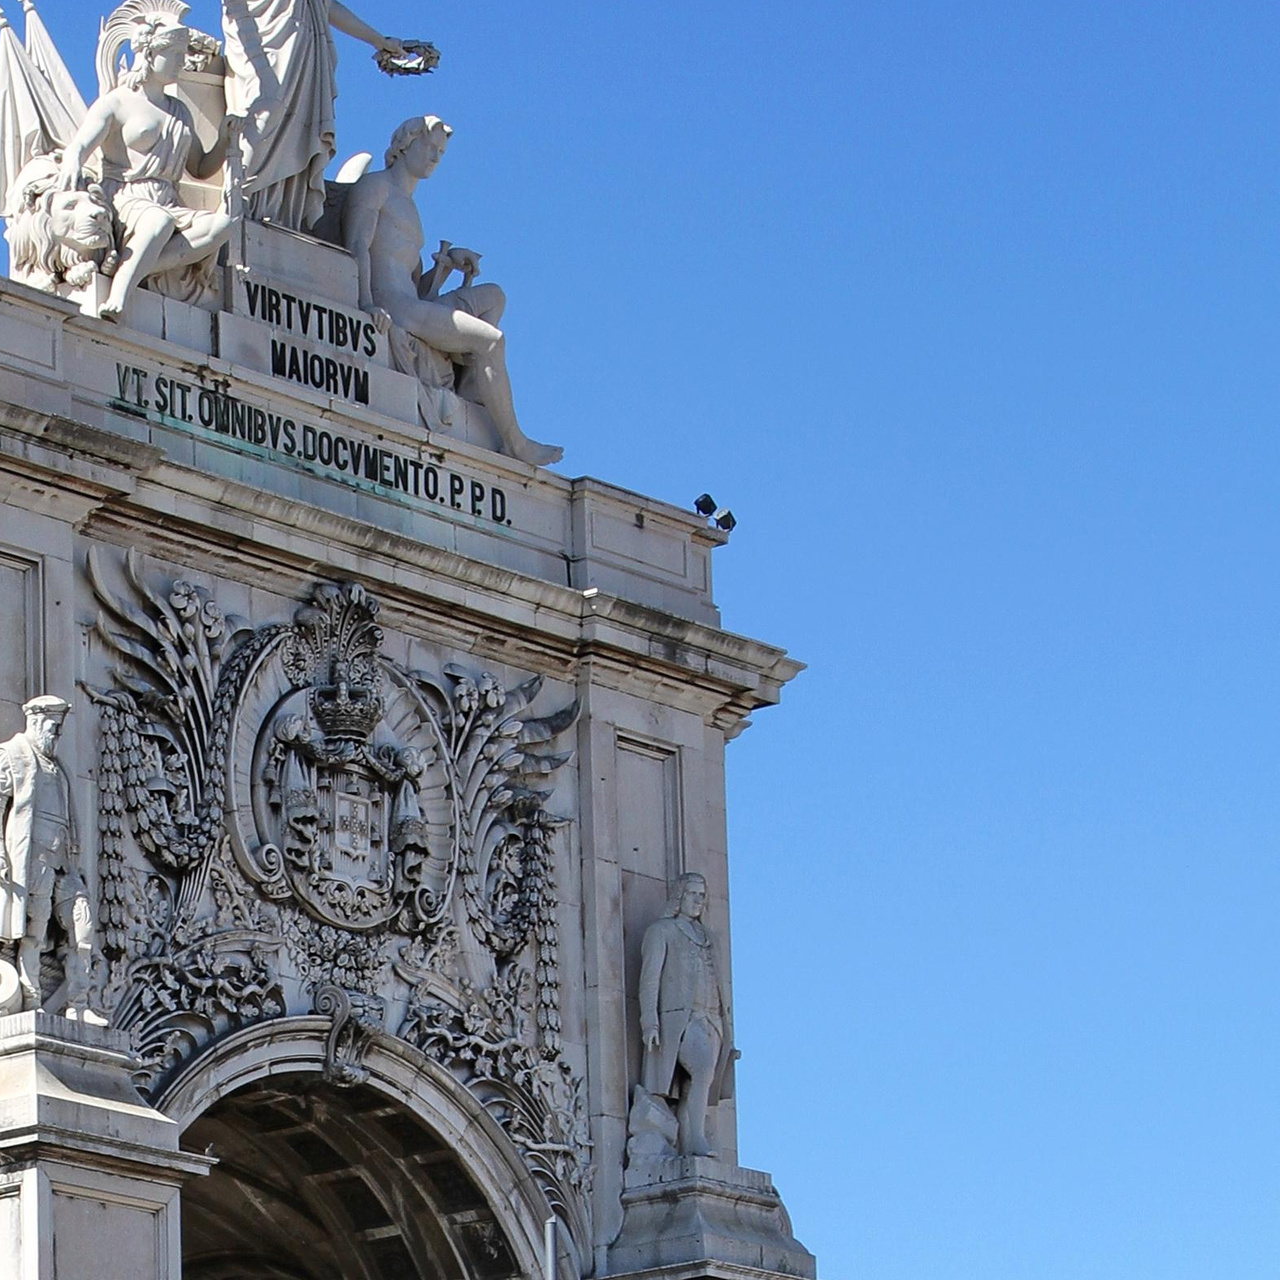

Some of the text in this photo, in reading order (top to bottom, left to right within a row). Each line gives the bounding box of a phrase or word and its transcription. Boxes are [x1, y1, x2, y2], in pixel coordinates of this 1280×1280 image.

[245, 280, 376, 357] VIRTVTIBVS
[155, 376, 193, 422] SIT.
[271, 339, 369, 405] MAIORVM
